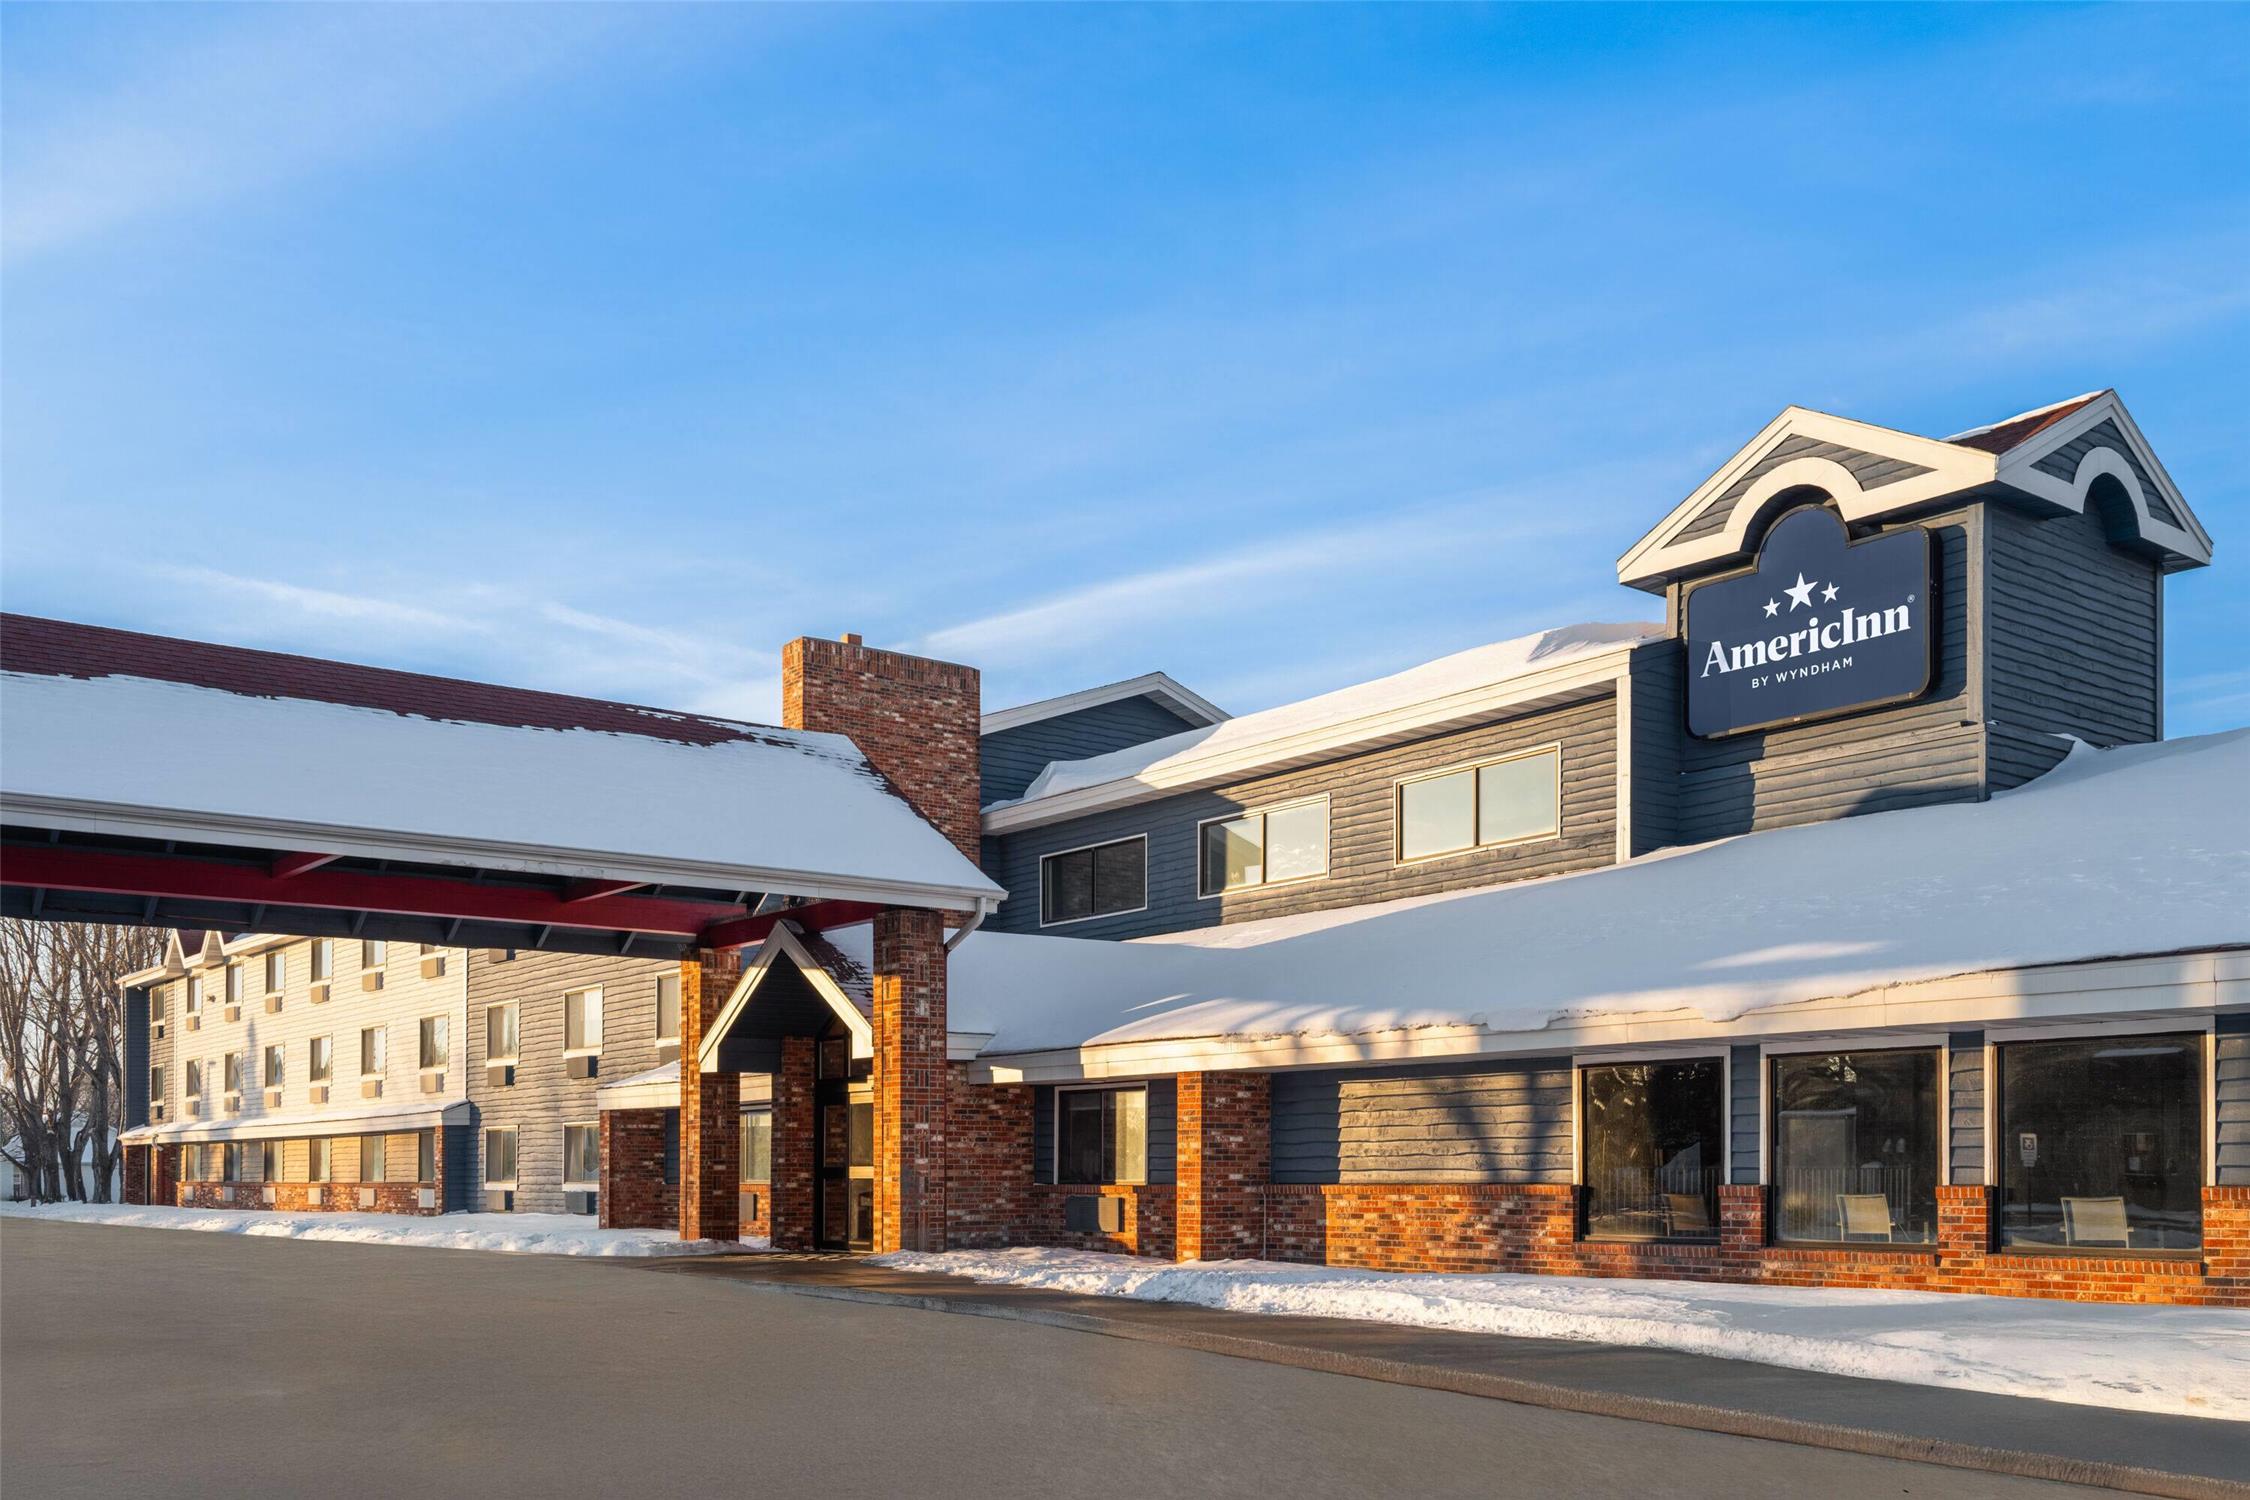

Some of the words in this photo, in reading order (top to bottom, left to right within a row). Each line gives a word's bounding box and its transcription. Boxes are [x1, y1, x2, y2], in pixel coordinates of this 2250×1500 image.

[1700, 604, 1911, 678] AmericInn
[1751, 675, 1769, 689] BY
[1775, 656, 1853, 683] WYNDHAM
